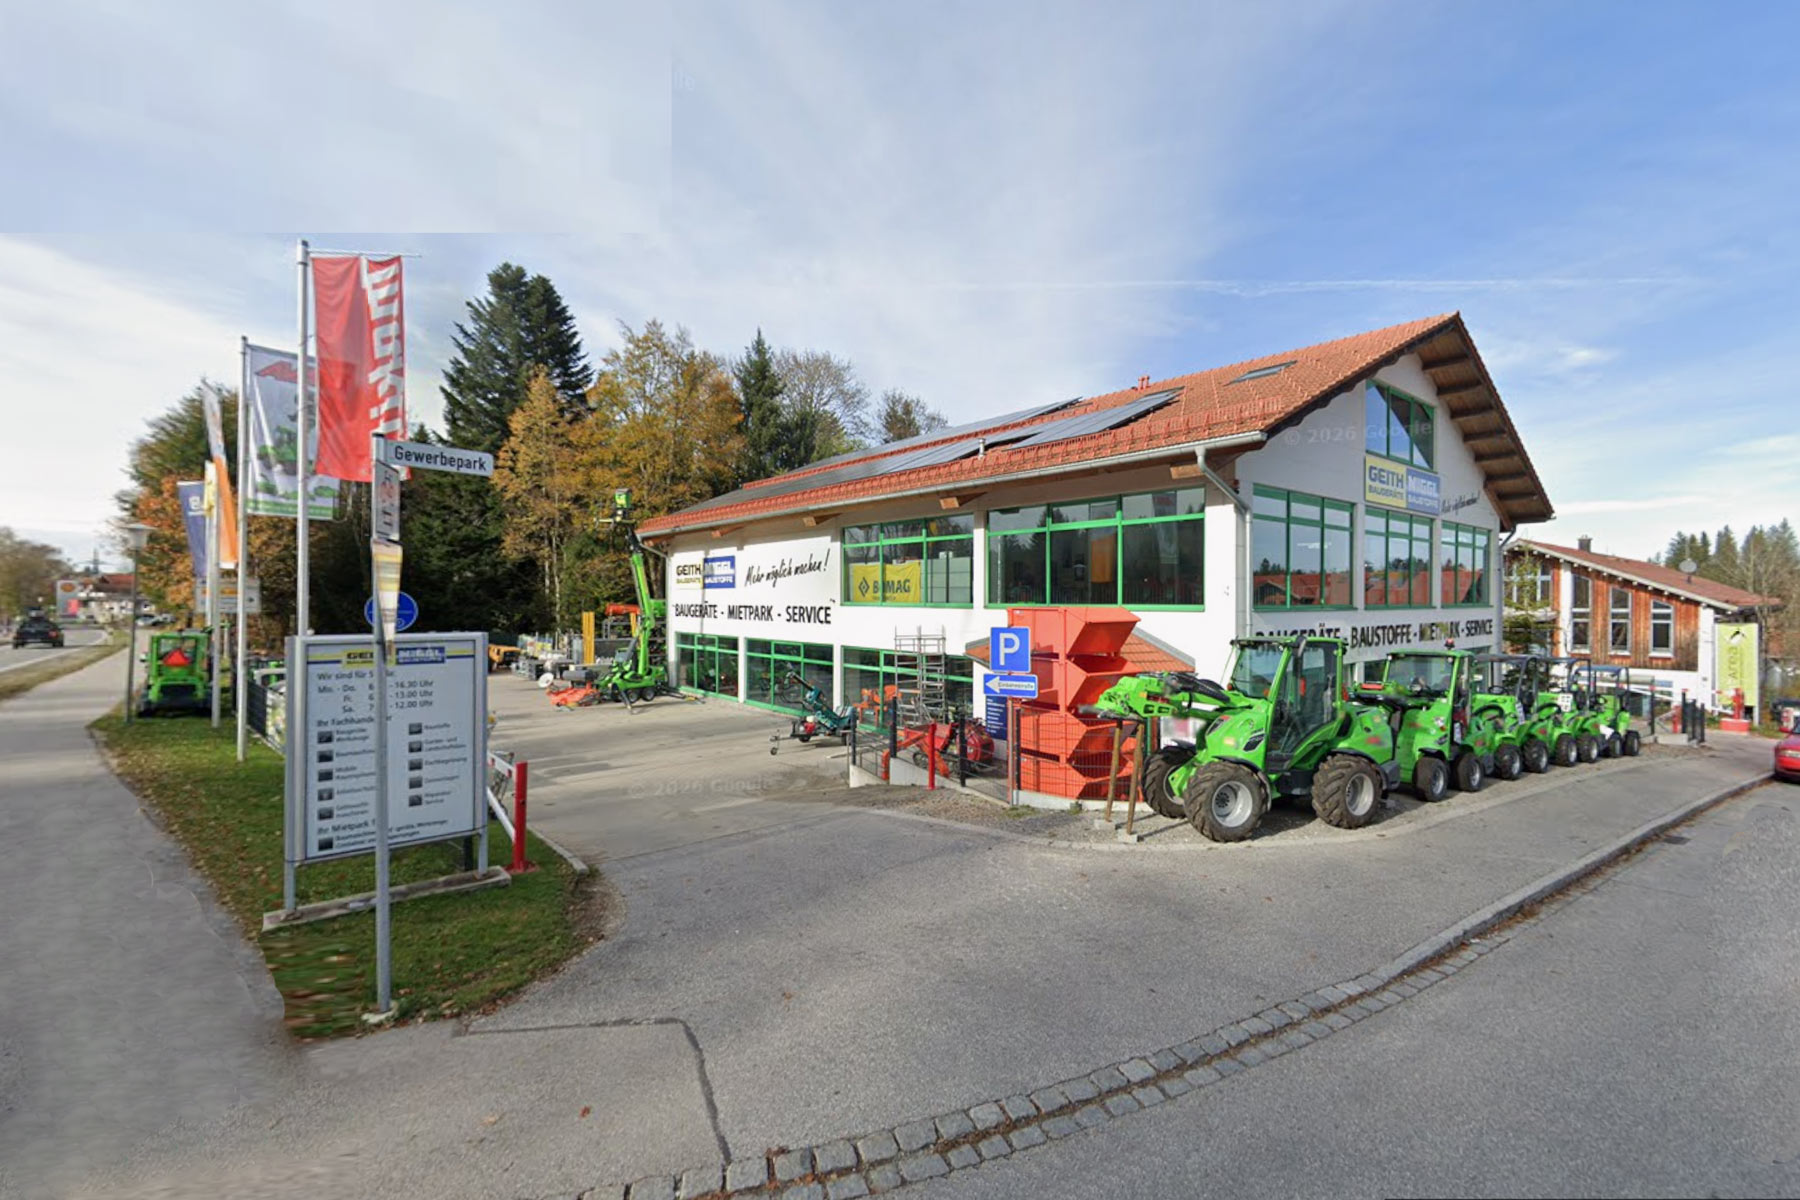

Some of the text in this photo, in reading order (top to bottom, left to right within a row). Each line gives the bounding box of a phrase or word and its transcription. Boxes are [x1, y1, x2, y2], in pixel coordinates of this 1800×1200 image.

[394, 446, 487, 471] Gewerbepark
[1368, 465, 1404, 489] GEITH
[676, 563, 702, 576] GEITH
[764, 558, 793, 588] möglich
[872, 579, 911, 594] BMAG
[674, 601, 718, 619] BAUGERÄTE
[727, 604, 773, 621] MIETPARK
[785, 605, 832, 624] SERVICE
[1351, 624, 1411, 650] BAUSTOFFE
[1465, 619, 1493, 637] SERVICE
[999, 632, 1020, 666] P
[419, 679, 434, 688] Uhr
[419, 689, 434, 698] Uhr
[419, 700, 433, 708] Uhr
